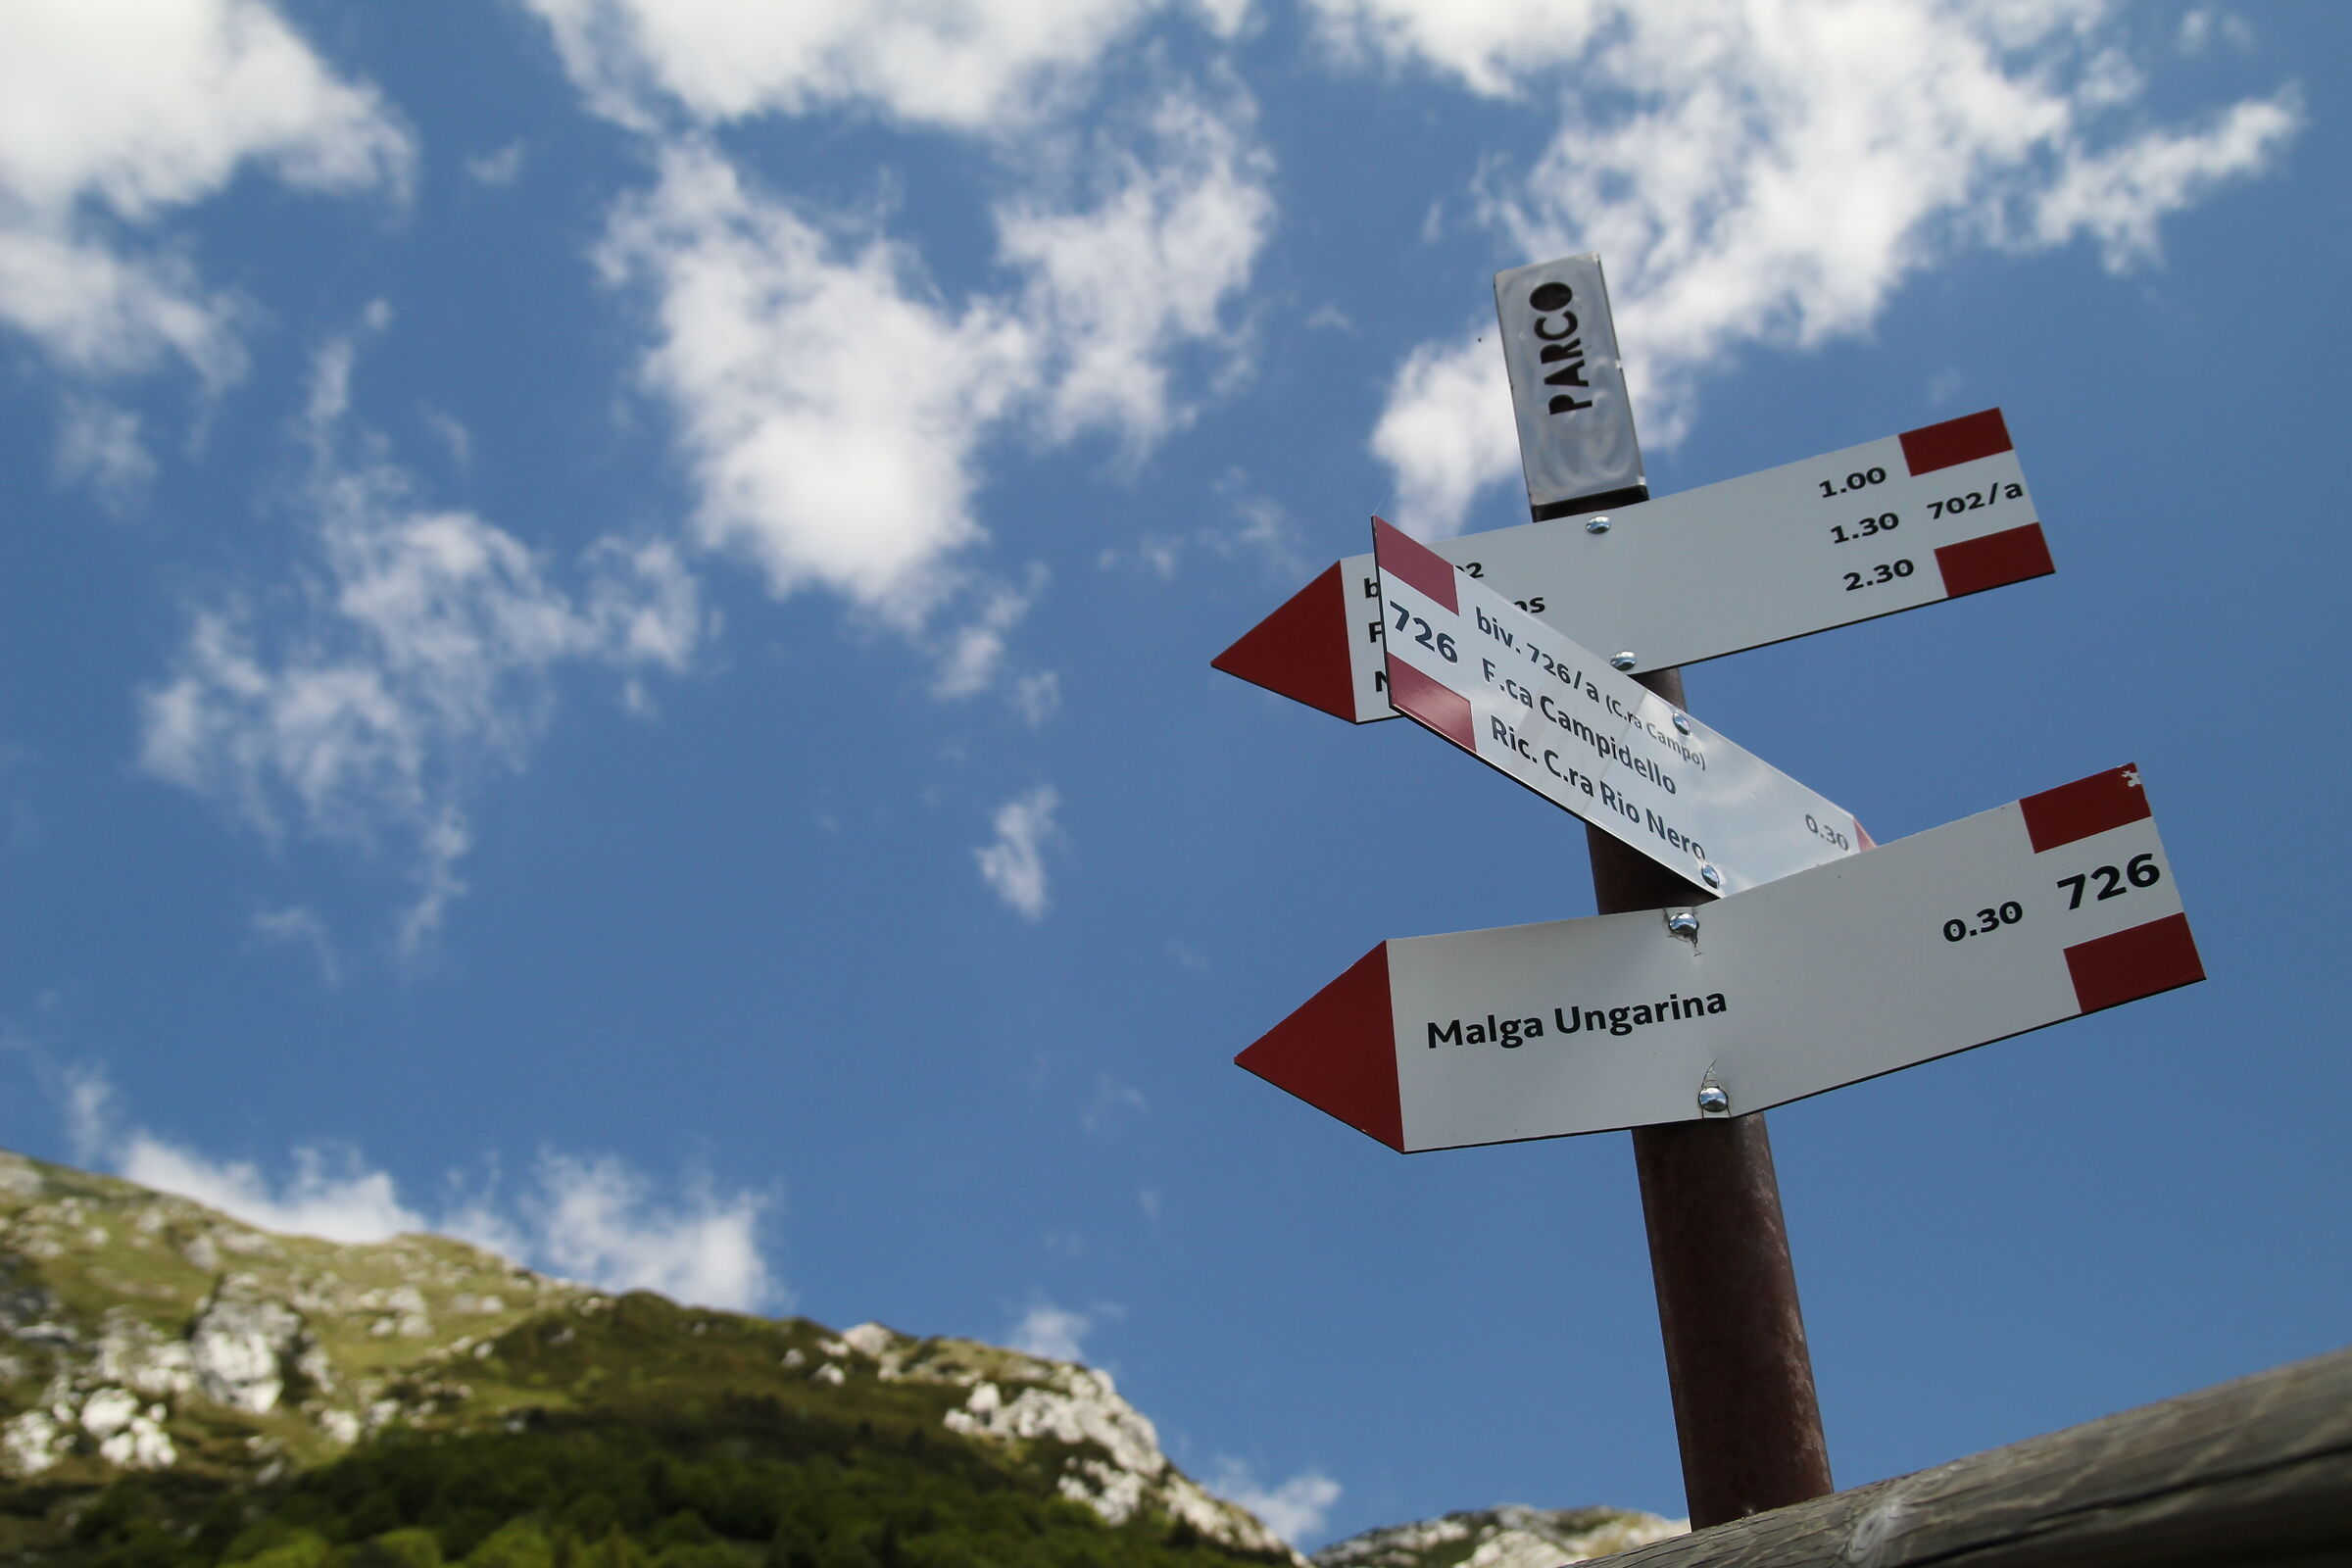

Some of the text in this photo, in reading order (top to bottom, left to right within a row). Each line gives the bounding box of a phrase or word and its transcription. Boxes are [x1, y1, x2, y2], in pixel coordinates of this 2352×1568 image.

[1530, 281, 1592, 416] PARCO
[1819, 466, 1886, 498] 1.00
[1927, 482, 2024, 519] 702/a
[1830, 512, 1899, 544] 1.30
[1842, 559, 1914, 592] 2.30
[1390, 600, 1458, 664] 726
[1475, 606, 1521, 655] biv.
[1605, 695, 1643, 730] (C.ra
[1646, 724, 1706, 771] Campo)
[1540, 695, 1677, 795] Campidello
[1490, 714, 1706, 861] Ric. C.ra Rio Nero
[1805, 813, 1849, 851] 0.30
[2057, 853, 2161, 911] 726
[1942, 901, 2024, 943] 0.30
[1427, 992, 1728, 1049] Malga Ungarina
